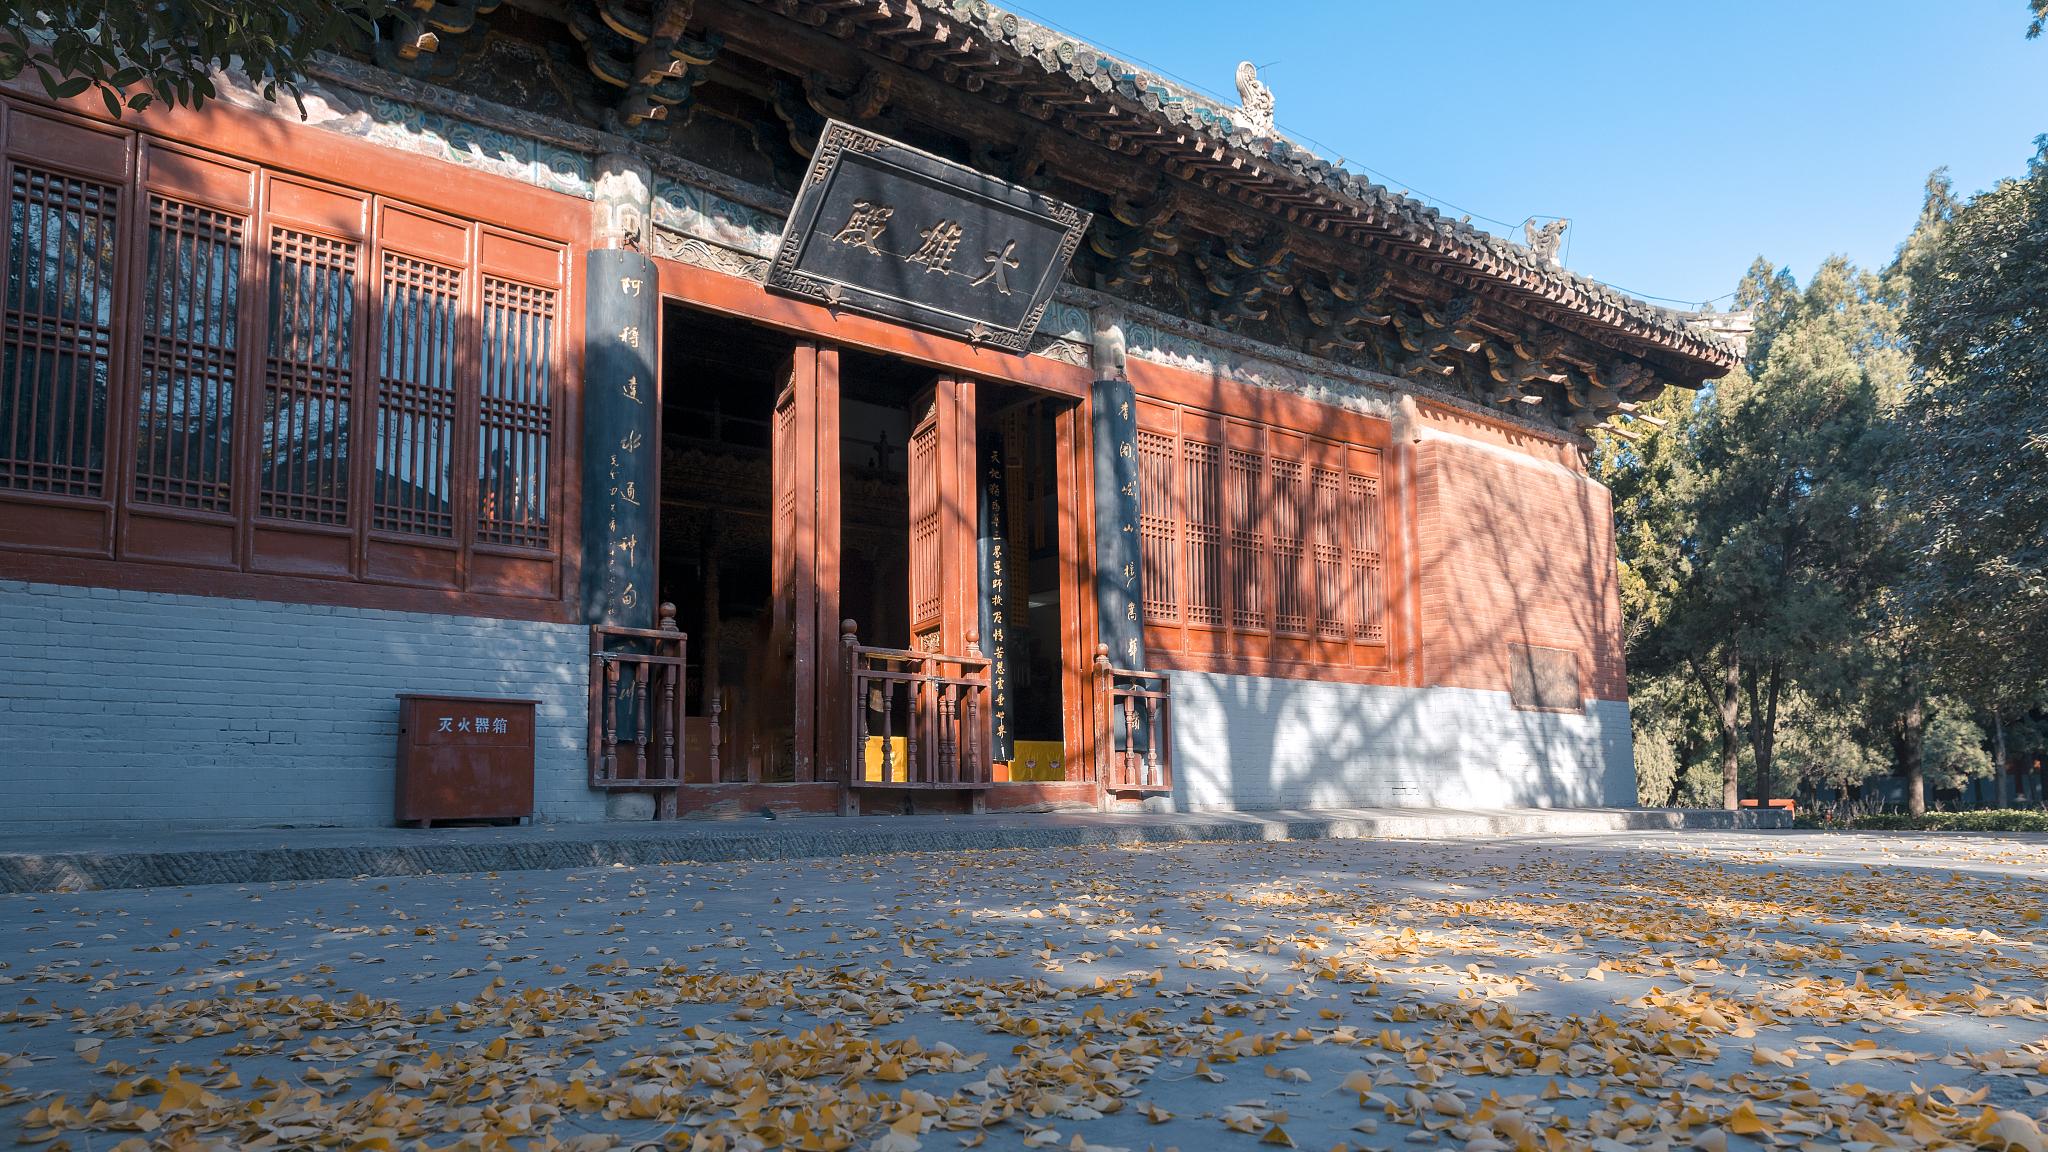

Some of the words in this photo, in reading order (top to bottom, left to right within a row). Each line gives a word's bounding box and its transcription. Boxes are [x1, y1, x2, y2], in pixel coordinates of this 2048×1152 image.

[832, 201, 1020, 296] 大雄殿
[438, 717, 508, 734] 灭火器箱
